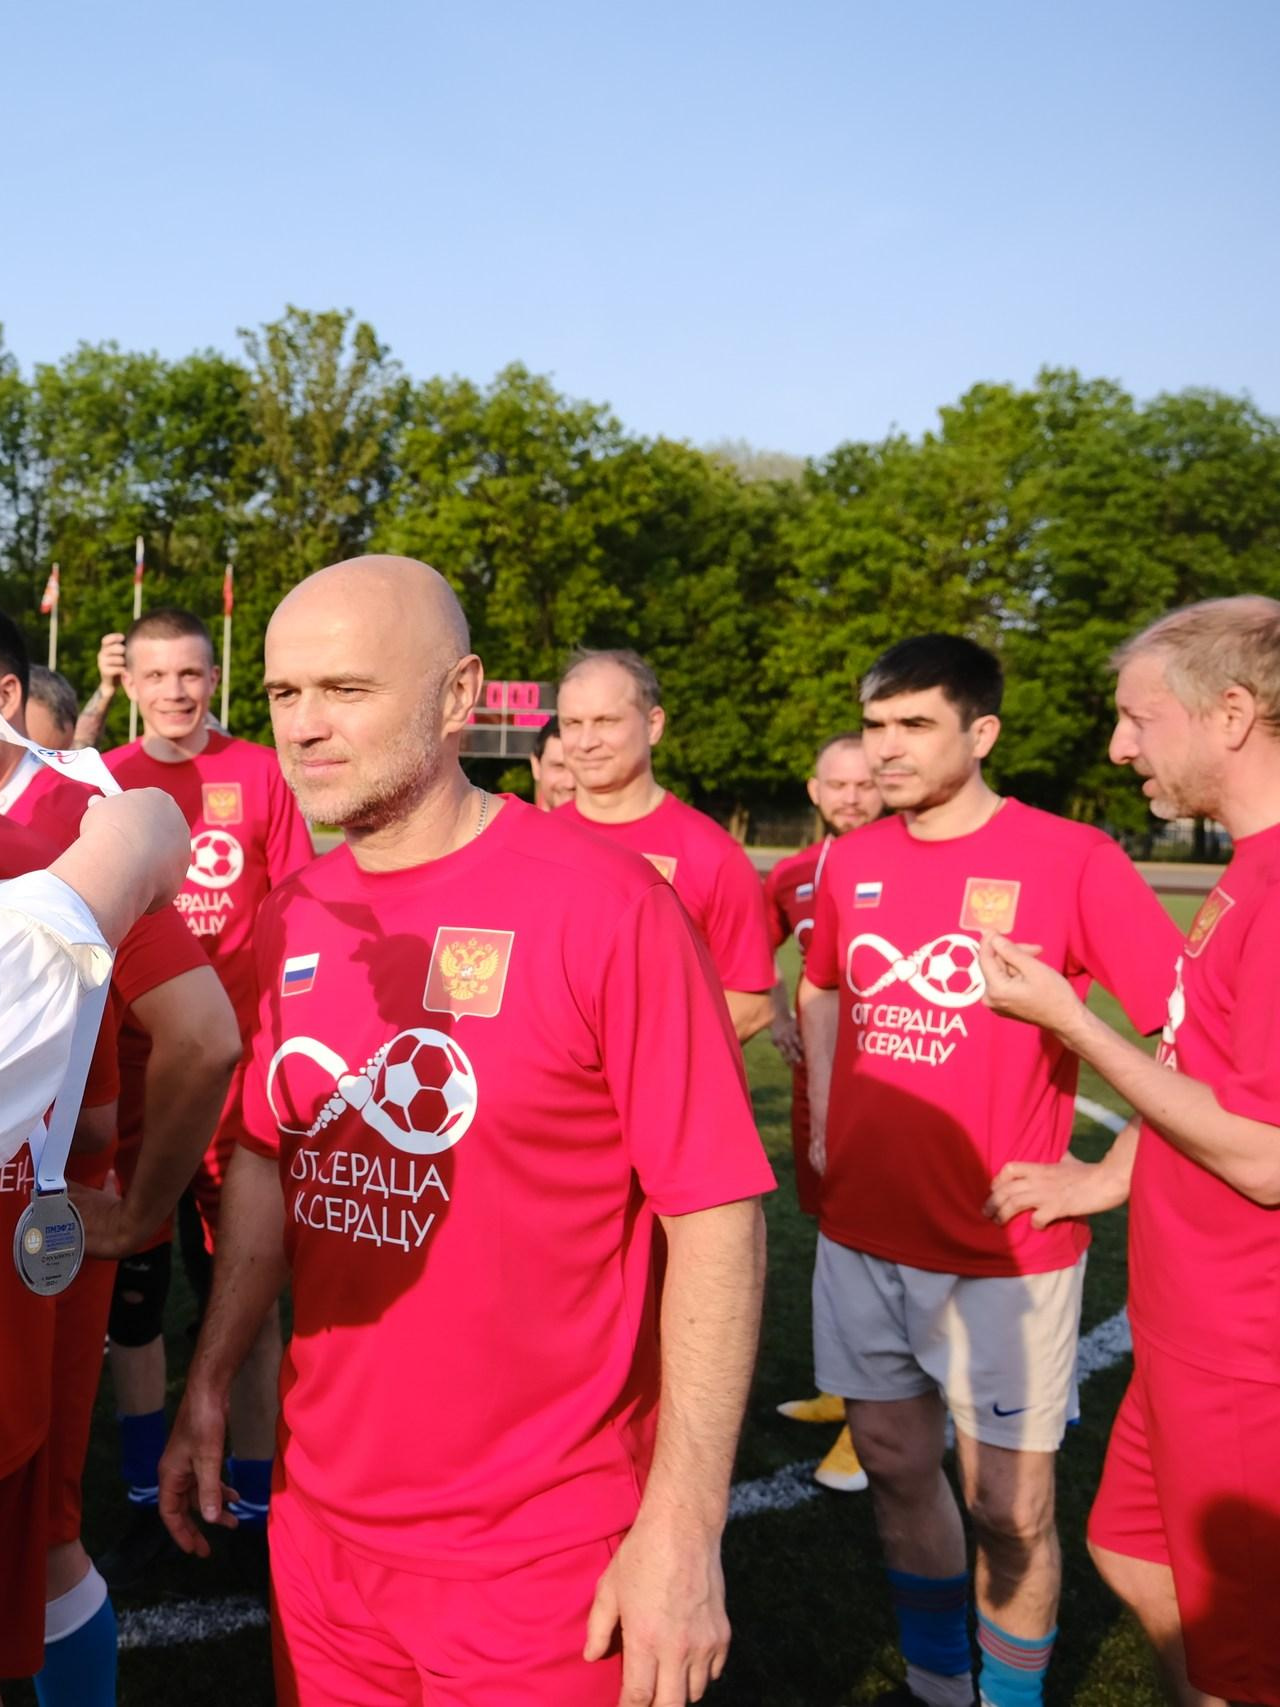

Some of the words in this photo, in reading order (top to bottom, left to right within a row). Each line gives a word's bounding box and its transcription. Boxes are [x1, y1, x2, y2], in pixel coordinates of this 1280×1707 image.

[851, 1003, 873, 1025] ОТ
[873, 1005, 968, 1038] СЕРДЦА
[865, 1032, 956, 1067] СЕРДЦУ
[290, 1148, 320, 1181] ОТ
[318, 1151, 450, 1204] СЕРДЦА
[294, 1191, 308, 1225] К
[308, 1194, 435, 1252] СЕРДЦУ
